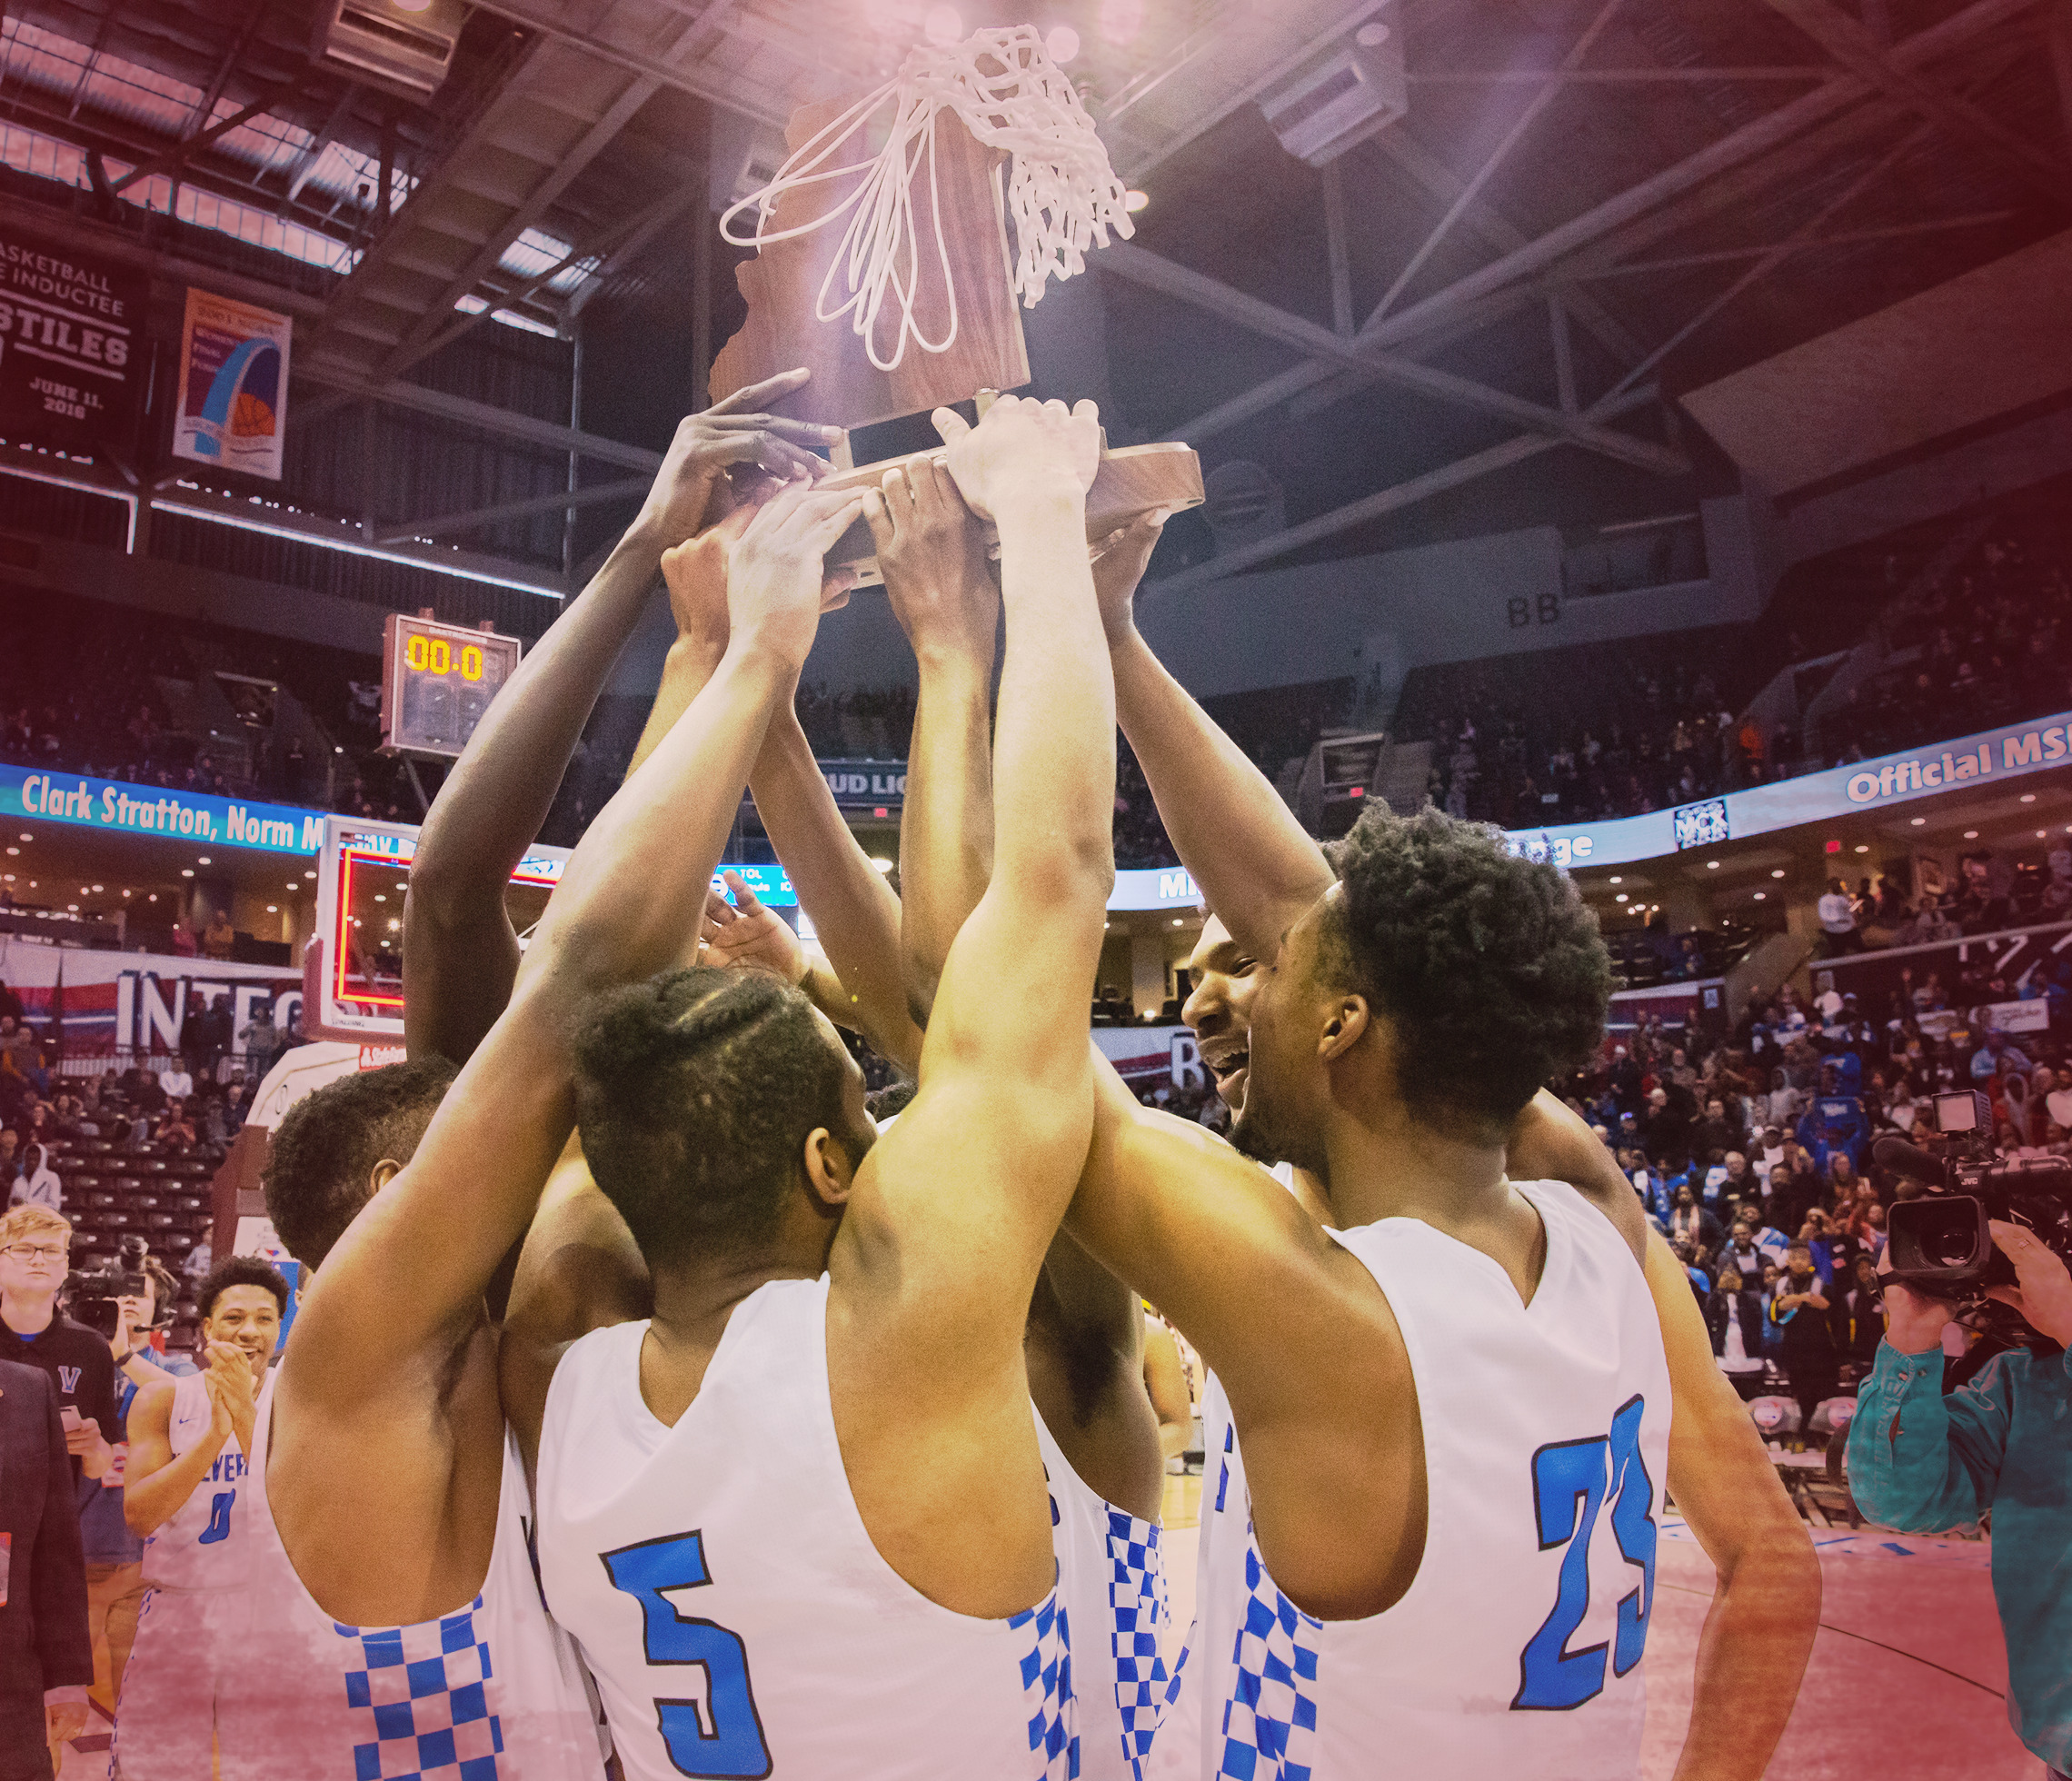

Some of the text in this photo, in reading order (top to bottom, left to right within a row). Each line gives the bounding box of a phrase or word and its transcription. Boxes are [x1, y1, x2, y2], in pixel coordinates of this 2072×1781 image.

[13, 267, 124, 317] INDUCTEE
[29, 376, 78, 402] JUNE
[408, 634, 483, 682] 00.0
[825, 773, 869, 793] UD
[1847, 743, 1992, 803] Official
[22, 775, 93, 820] Clark
[101, 786, 218, 841] Stratton,
[227, 805, 294, 847] Norm
[1960, 1177, 1978, 1186] JVC
[57, 1365, 82, 1394] V
[1509, 1393, 1657, 1711] 23
[598, 1528, 773, 1780] 5
